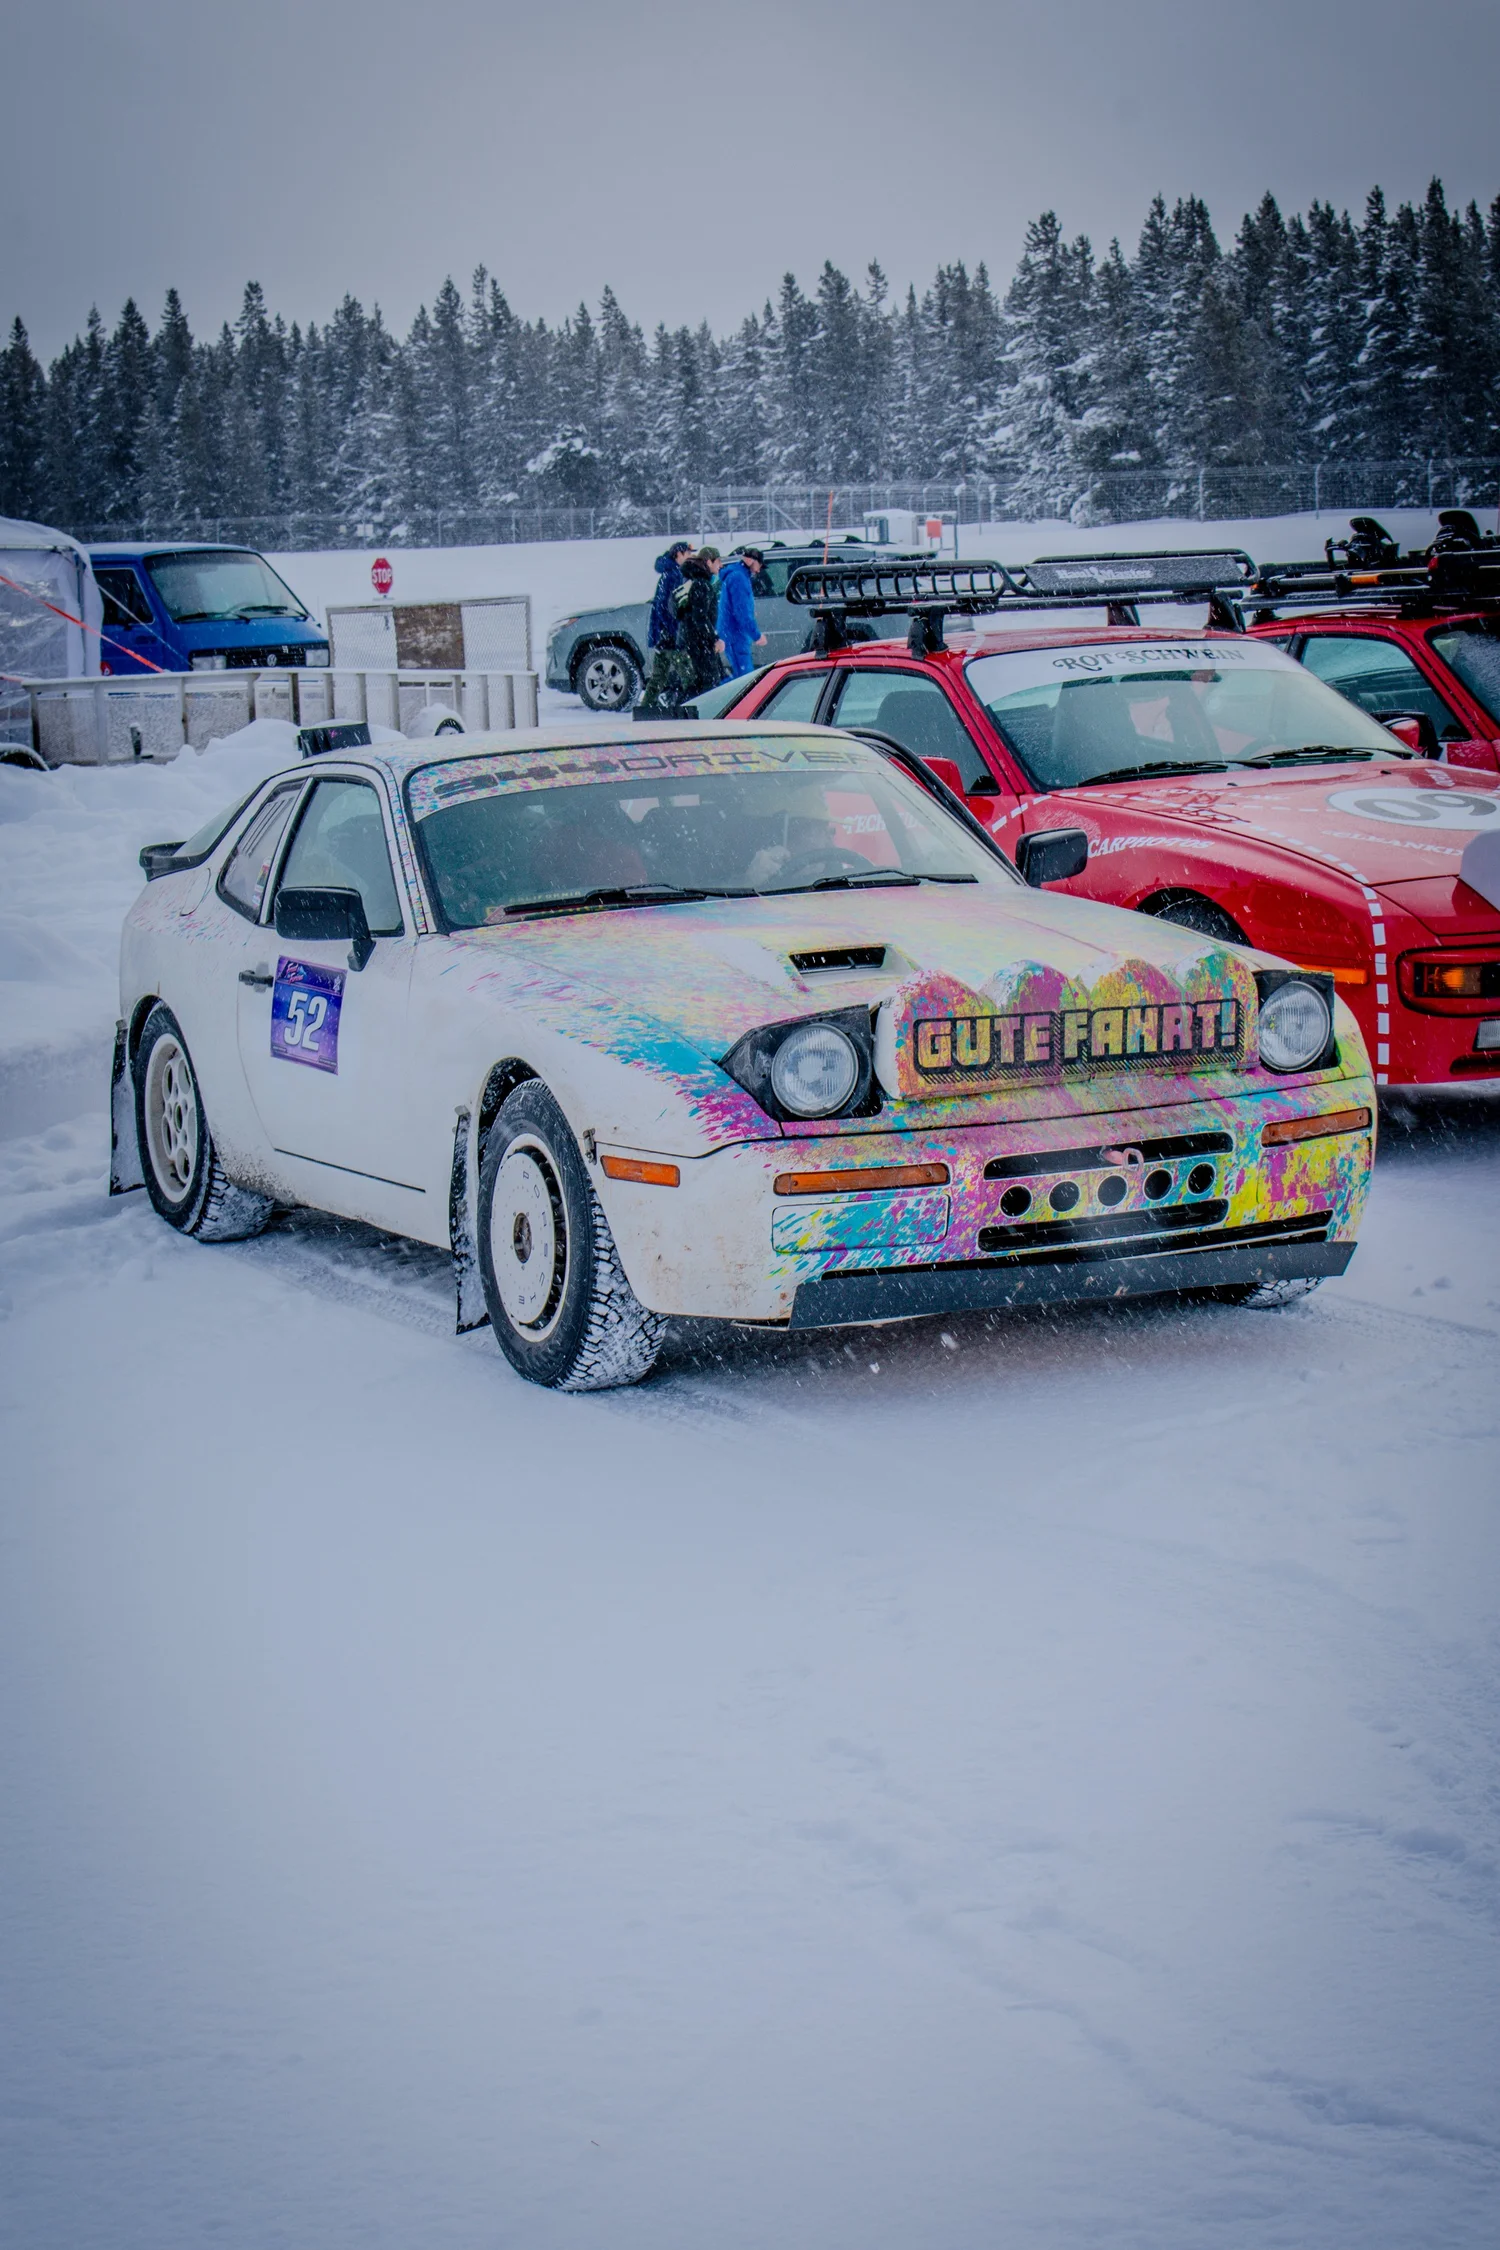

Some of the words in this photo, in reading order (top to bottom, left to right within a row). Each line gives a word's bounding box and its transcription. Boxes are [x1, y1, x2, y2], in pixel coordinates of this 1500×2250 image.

[372, 569, 391, 583] STOP
[283, 990, 328, 1052] 52
[917, 1012, 1051, 1069] GUTE
[1063, 999, 1237, 1060] FAHRT!
